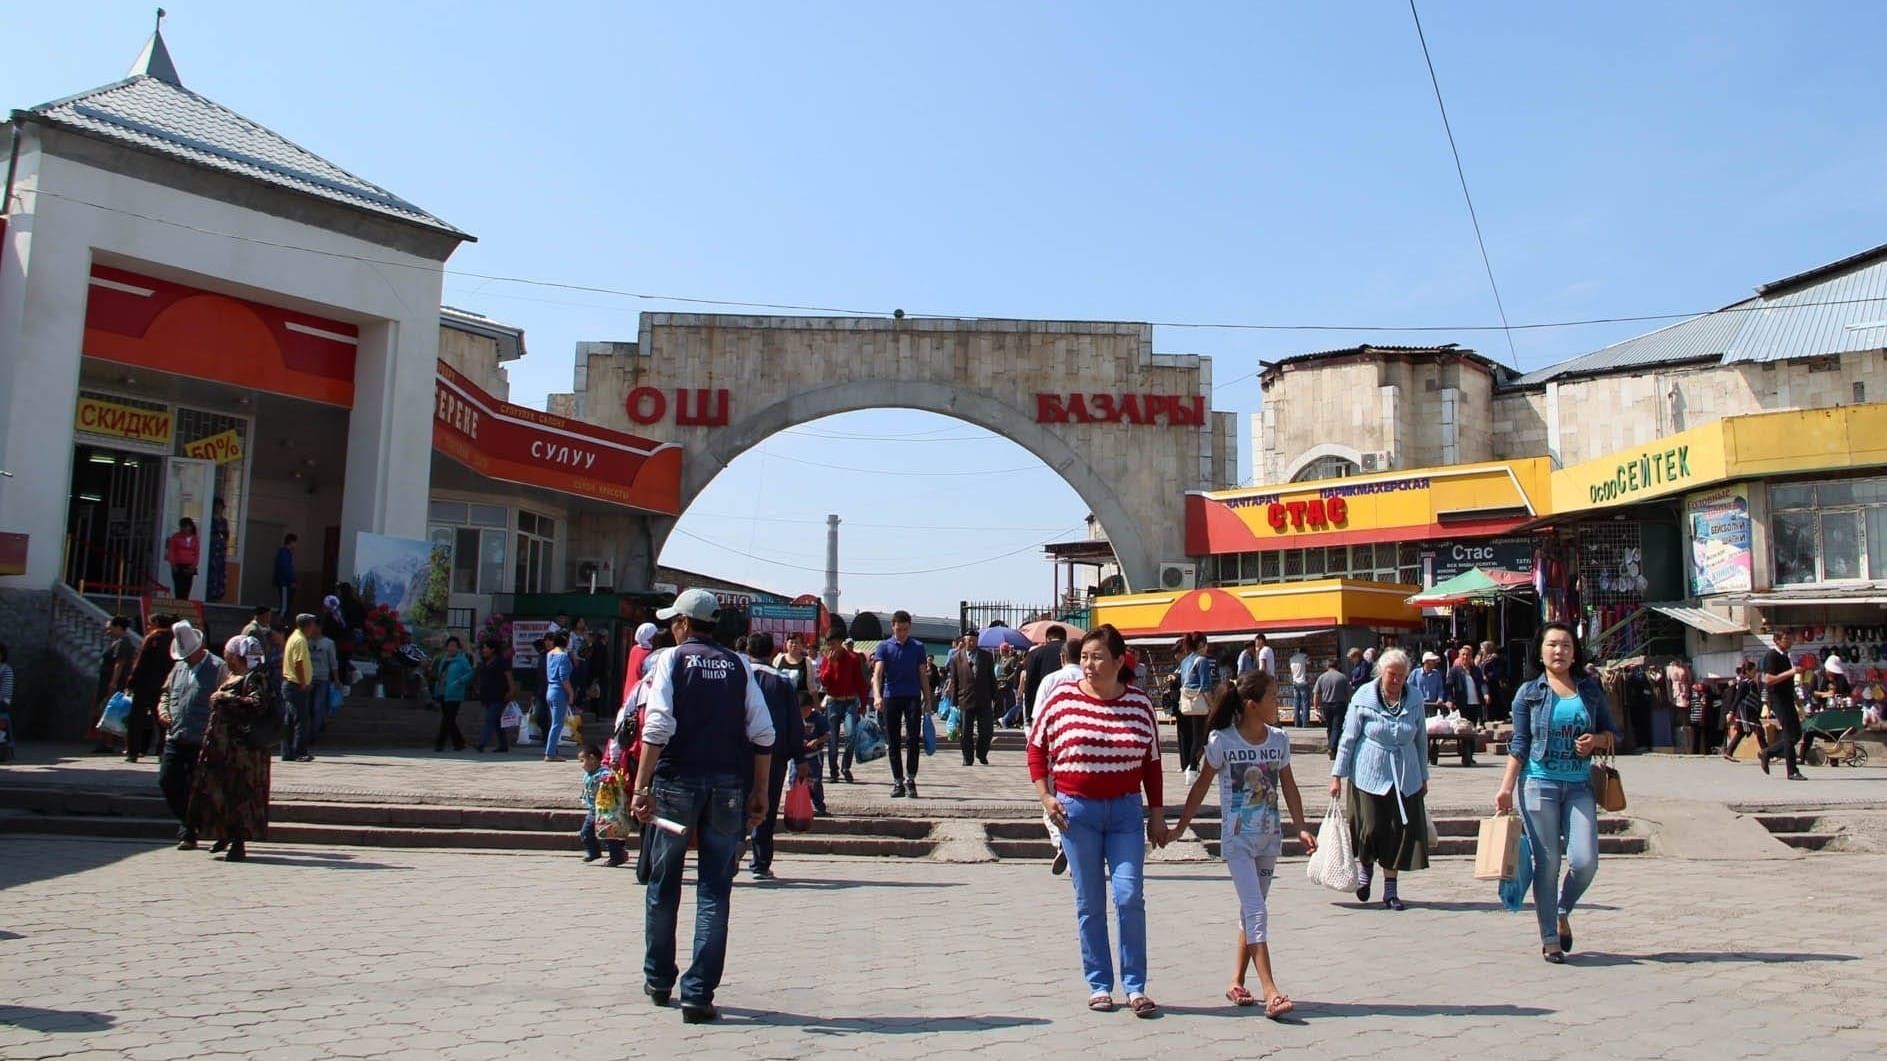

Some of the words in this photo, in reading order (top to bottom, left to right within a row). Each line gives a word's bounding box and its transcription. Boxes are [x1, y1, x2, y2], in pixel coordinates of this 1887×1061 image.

[81, 403, 169, 438] СКИДКИ
[626, 386, 729, 426] ОШ
[1036, 393, 1206, 427] БАЗАРЫ
[1319, 478, 1431, 499] ПАРИКМАХЕРСКАЯ
[1267, 497, 1347, 529] СТАС
[1452, 545, 1494, 560] Стас
